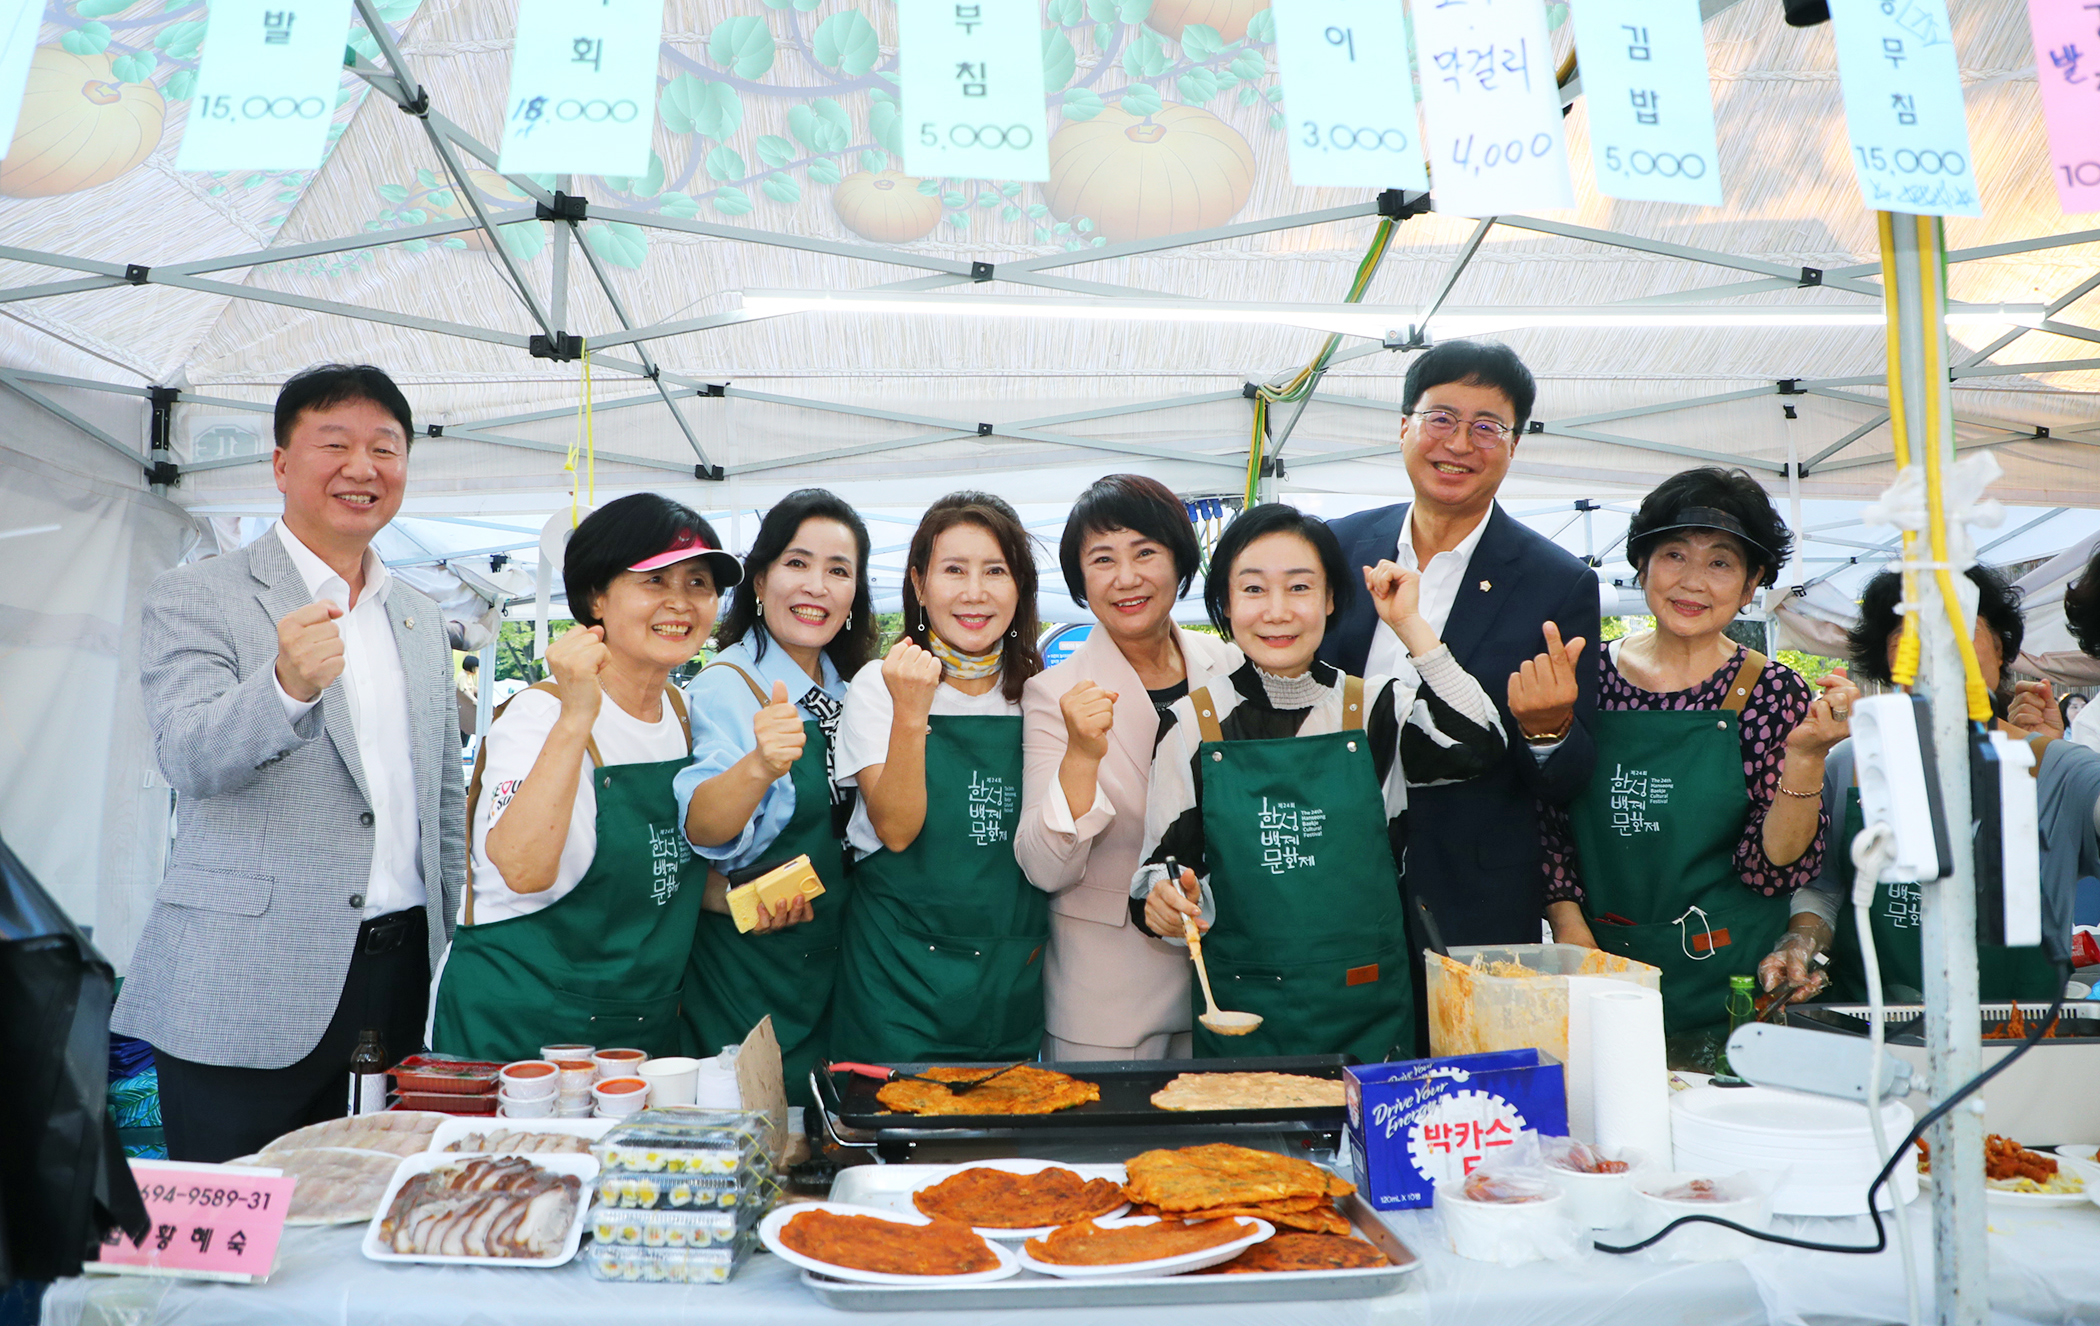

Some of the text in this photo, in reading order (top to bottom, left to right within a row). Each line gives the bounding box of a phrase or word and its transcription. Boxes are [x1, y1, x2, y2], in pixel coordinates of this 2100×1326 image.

[264, 9, 297, 45] 발
[1324, 26, 1355, 62] 이
[571, 36, 603, 72] 회
[1433, 37, 1531, 94] 막걸리
[1621, 24, 1660, 126] 김밥
[1452, 133, 1553, 178] 4,000
[1605, 146, 1706, 180] 5,000
[1855, 145, 1966, 178] 15,000
[968, 770, 1003, 806] 한성
[1610, 763, 1648, 798] 한성
[969, 803, 1002, 820] 백제
[1258, 796, 1299, 832] 한성
[1610, 795, 1646, 811] 백제
[648, 822, 679, 858] 한성
[968, 820, 1008, 846] 문화제
[1260, 830, 1300, 848] 백제
[1610, 811, 1661, 837] 문화제
[653, 858, 678, 877] 백제
[1260, 846, 1316, 875] 문화제
[1882, 901, 1922, 929] 문화
[1372, 1082, 1449, 1127] Drive Your
[1385, 1095, 1444, 1139] Energy!
[1423, 1118, 1514, 1154] 박카스
